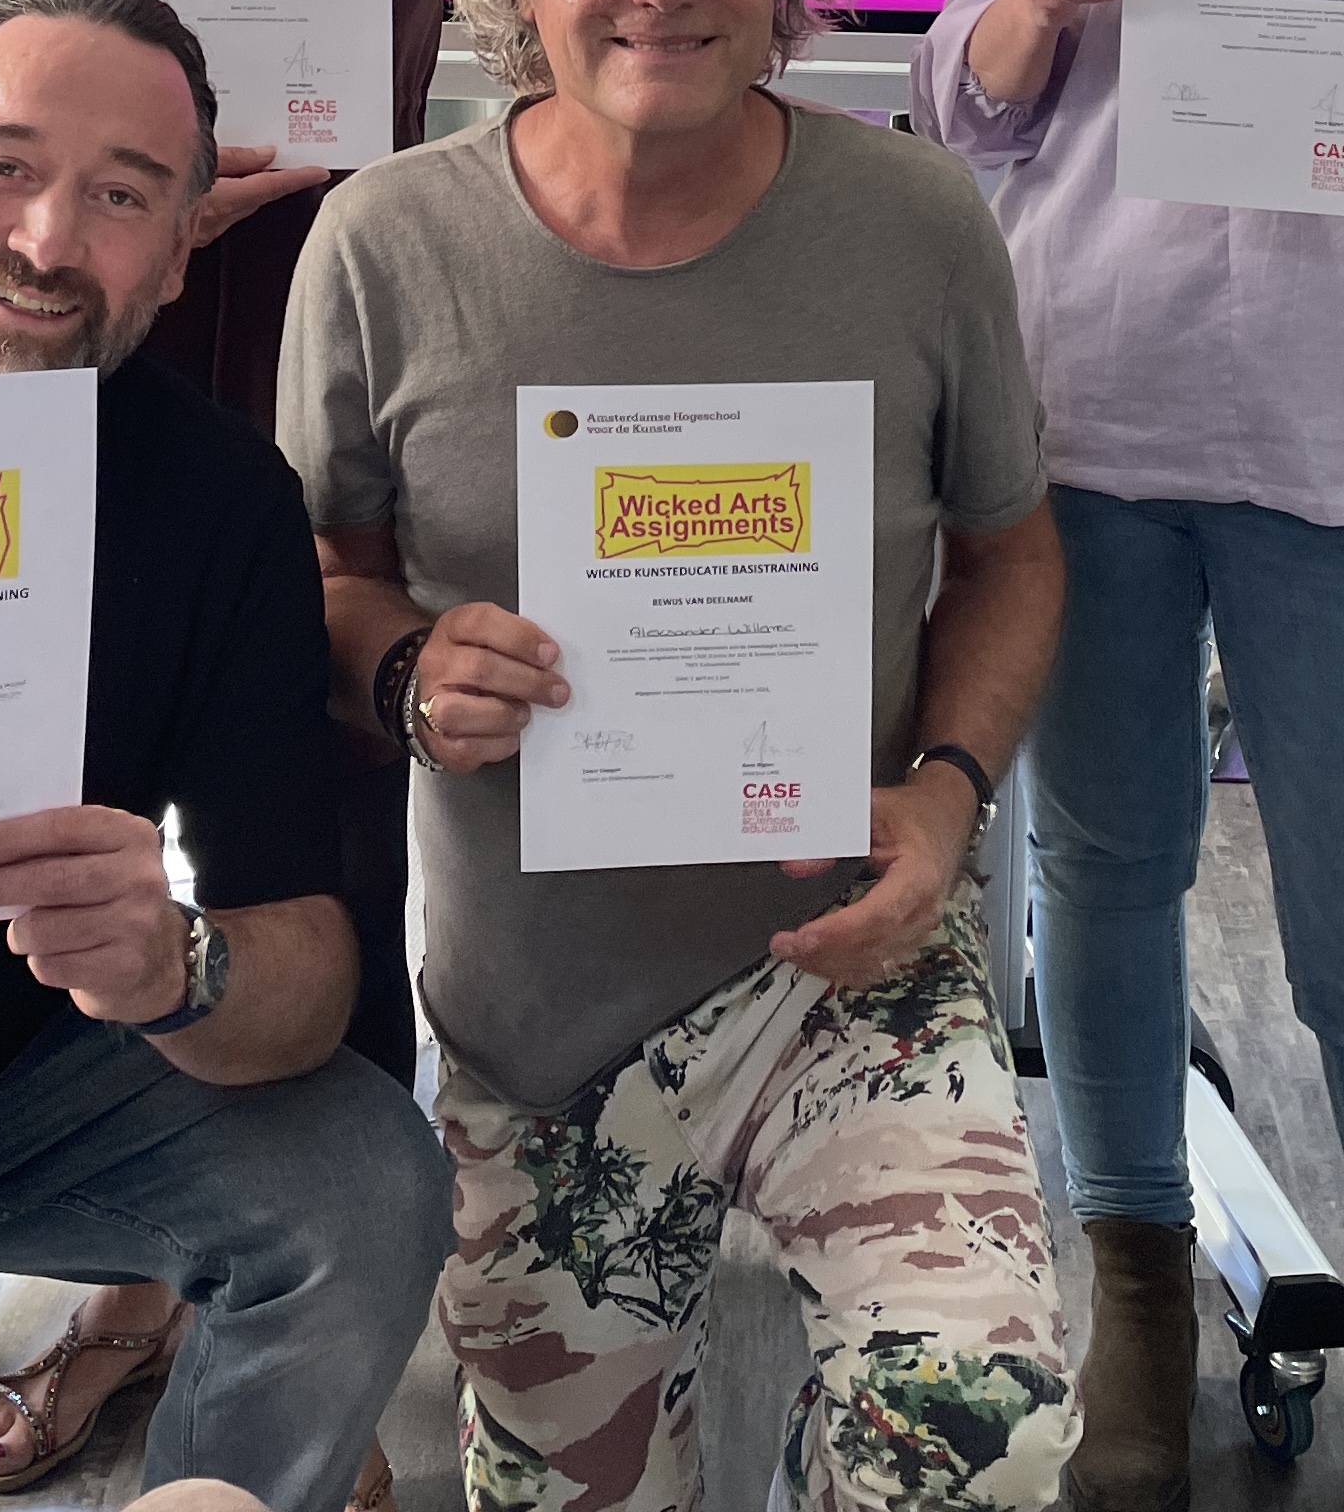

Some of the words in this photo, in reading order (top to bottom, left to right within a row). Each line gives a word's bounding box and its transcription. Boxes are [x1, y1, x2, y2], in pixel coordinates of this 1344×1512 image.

[288, 99, 337, 114] CASE
[587, 412, 671, 423] Amsterdamse
[673, 411, 741, 423] Hogeschool
[587, 426, 614, 434] voor
[616, 424, 630, 434] de
[632, 423, 682, 433] Kunsten
[618, 493, 721, 518] Wicked
[729, 492, 787, 515] Arts
[610, 513, 794, 543] Assignments
[586, 568, 632, 580] WICKED
[634, 564, 728, 578] KUNSTEDUCATIE
[732, 562, 819, 575] BASISTRAINING
[685, 597, 704, 605] VAN
[743, 783, 801, 799] CASE
